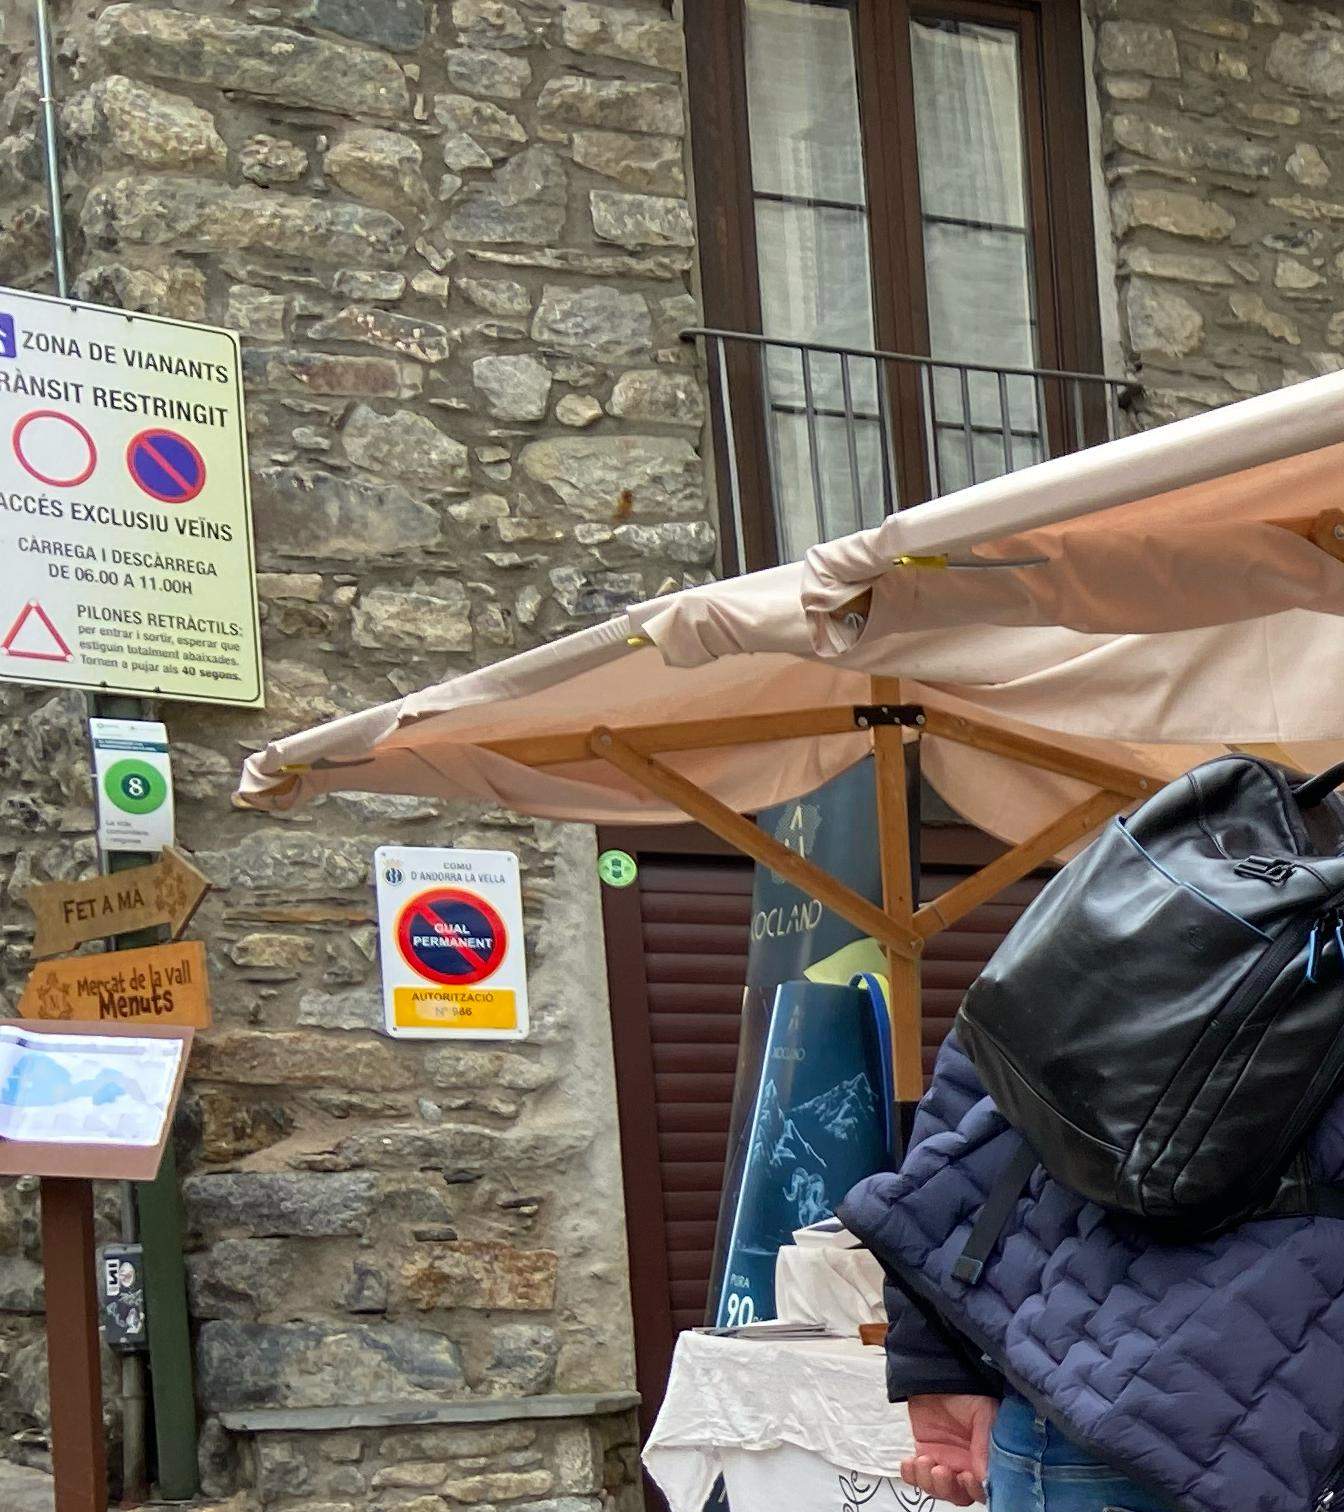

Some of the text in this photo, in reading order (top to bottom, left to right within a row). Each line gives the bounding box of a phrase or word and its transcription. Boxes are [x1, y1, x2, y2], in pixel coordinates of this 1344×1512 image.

[22, 330, 228, 384] ZONA DE VIANANTS
[0, 367, 228, 427] RÀNSIT RESTRINGIT
[71, 502, 168, 532] EXCLUSIU
[174, 517, 233, 541] VEÏNS
[18, 535, 218, 576] CÀRREGA I DESCÀRREGA
[49, 563, 193, 595] DE 06.00 A 11.00H
[77, 604, 142, 625] PILONES
[78, 625, 96, 635] per
[100, 625, 133, 639] entrar
[177, 636, 218, 650] esperar
[220, 640, 241, 652] que
[79, 640, 124, 654] estiguin
[131, 660, 160, 673] pujar
[182, 665, 196, 677] 40
[128, 777, 144, 796] 8
[63, 899, 96, 923] FET
[102, 895, 113, 915] A
[413, 935, 493, 949] PERMANENT
[435, 923, 471, 935] GUAL
[77, 972, 126, 997] Mercat
[129, 967, 145, 991] de
[149, 963, 162, 988] la
[98, 986, 174, 1019] Menuts
